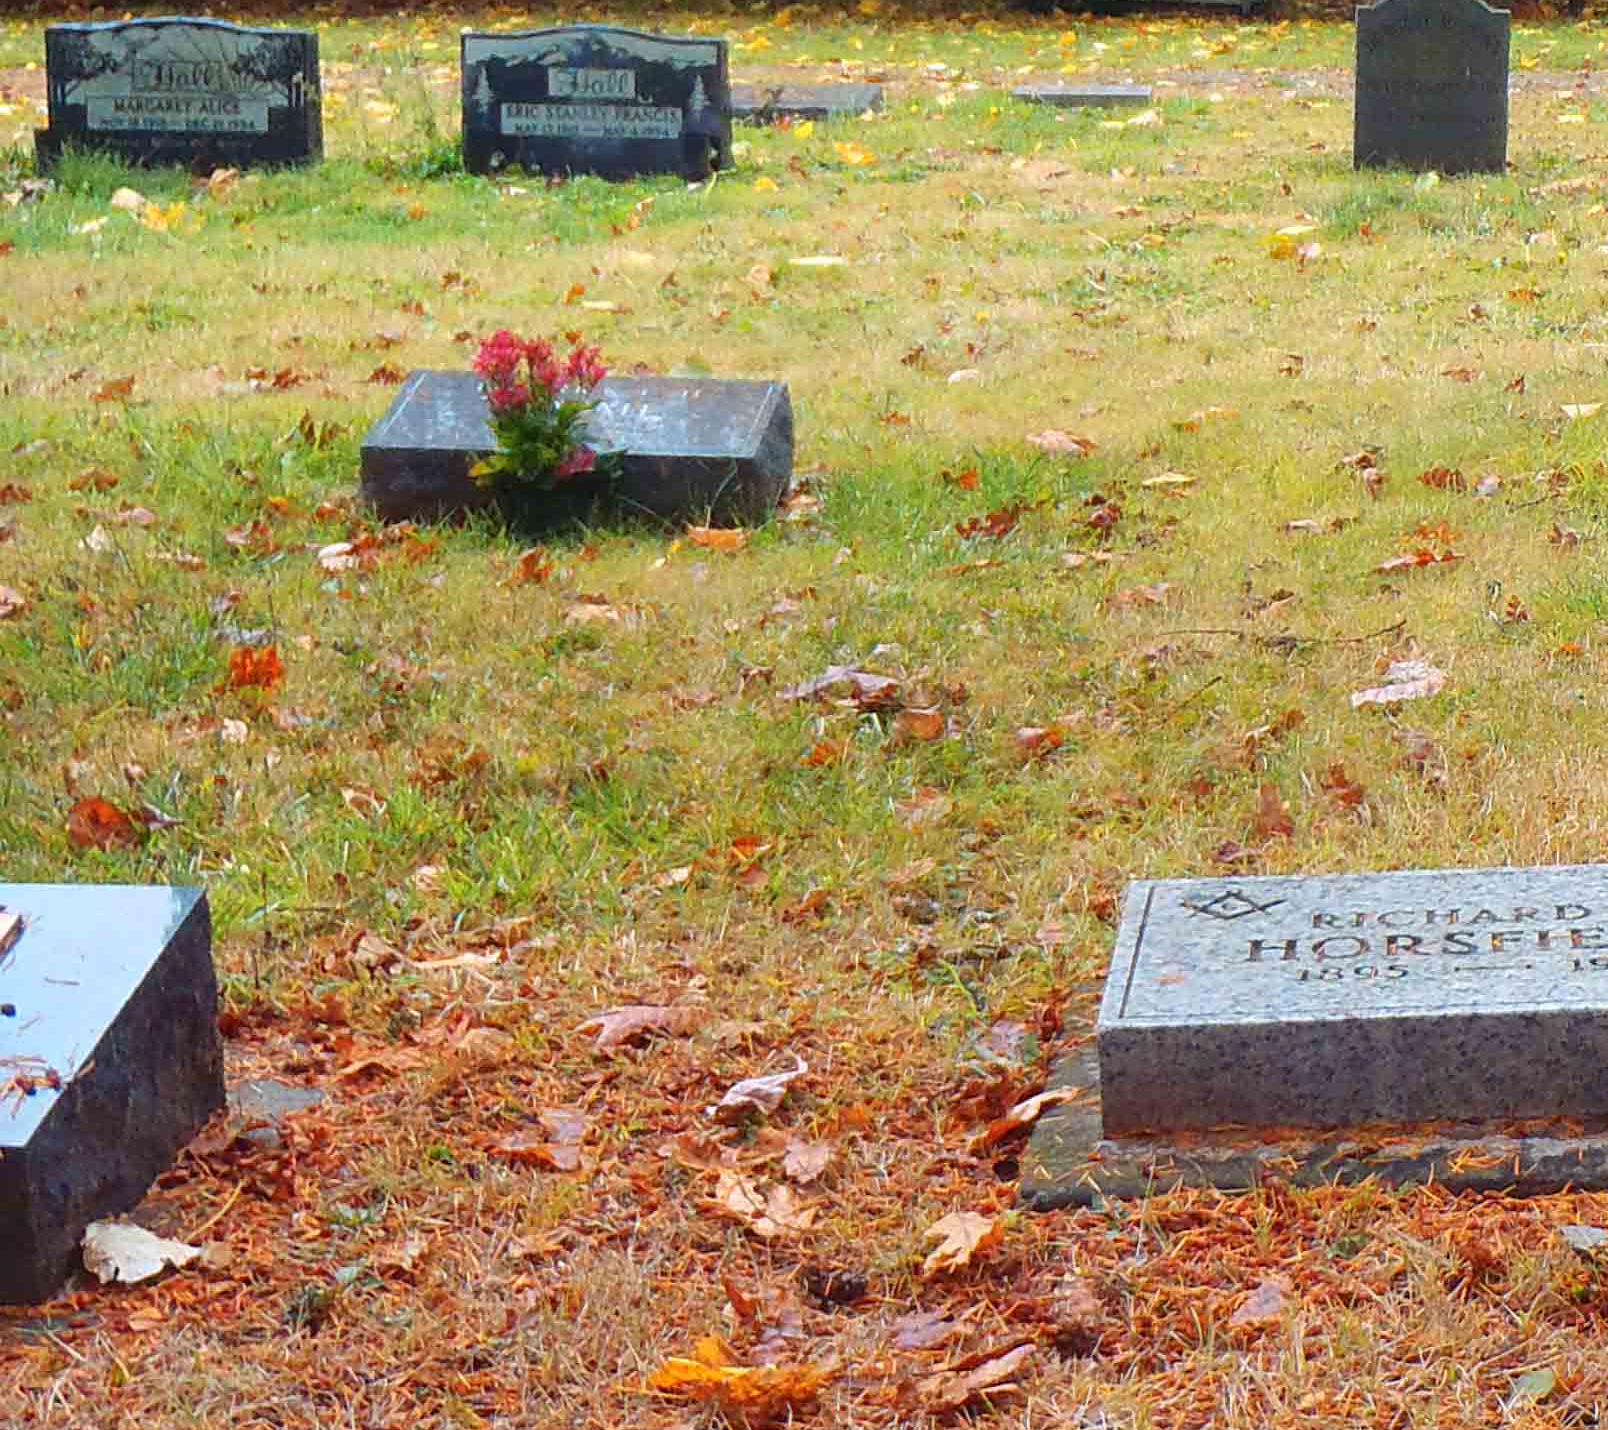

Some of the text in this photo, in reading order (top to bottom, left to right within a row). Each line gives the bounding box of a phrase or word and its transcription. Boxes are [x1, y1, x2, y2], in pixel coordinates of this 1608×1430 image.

[198, 98, 241, 115] ALICE
[1312, 903, 1593, 928] RICHARD
[1297, 964, 1409, 981] 1895
